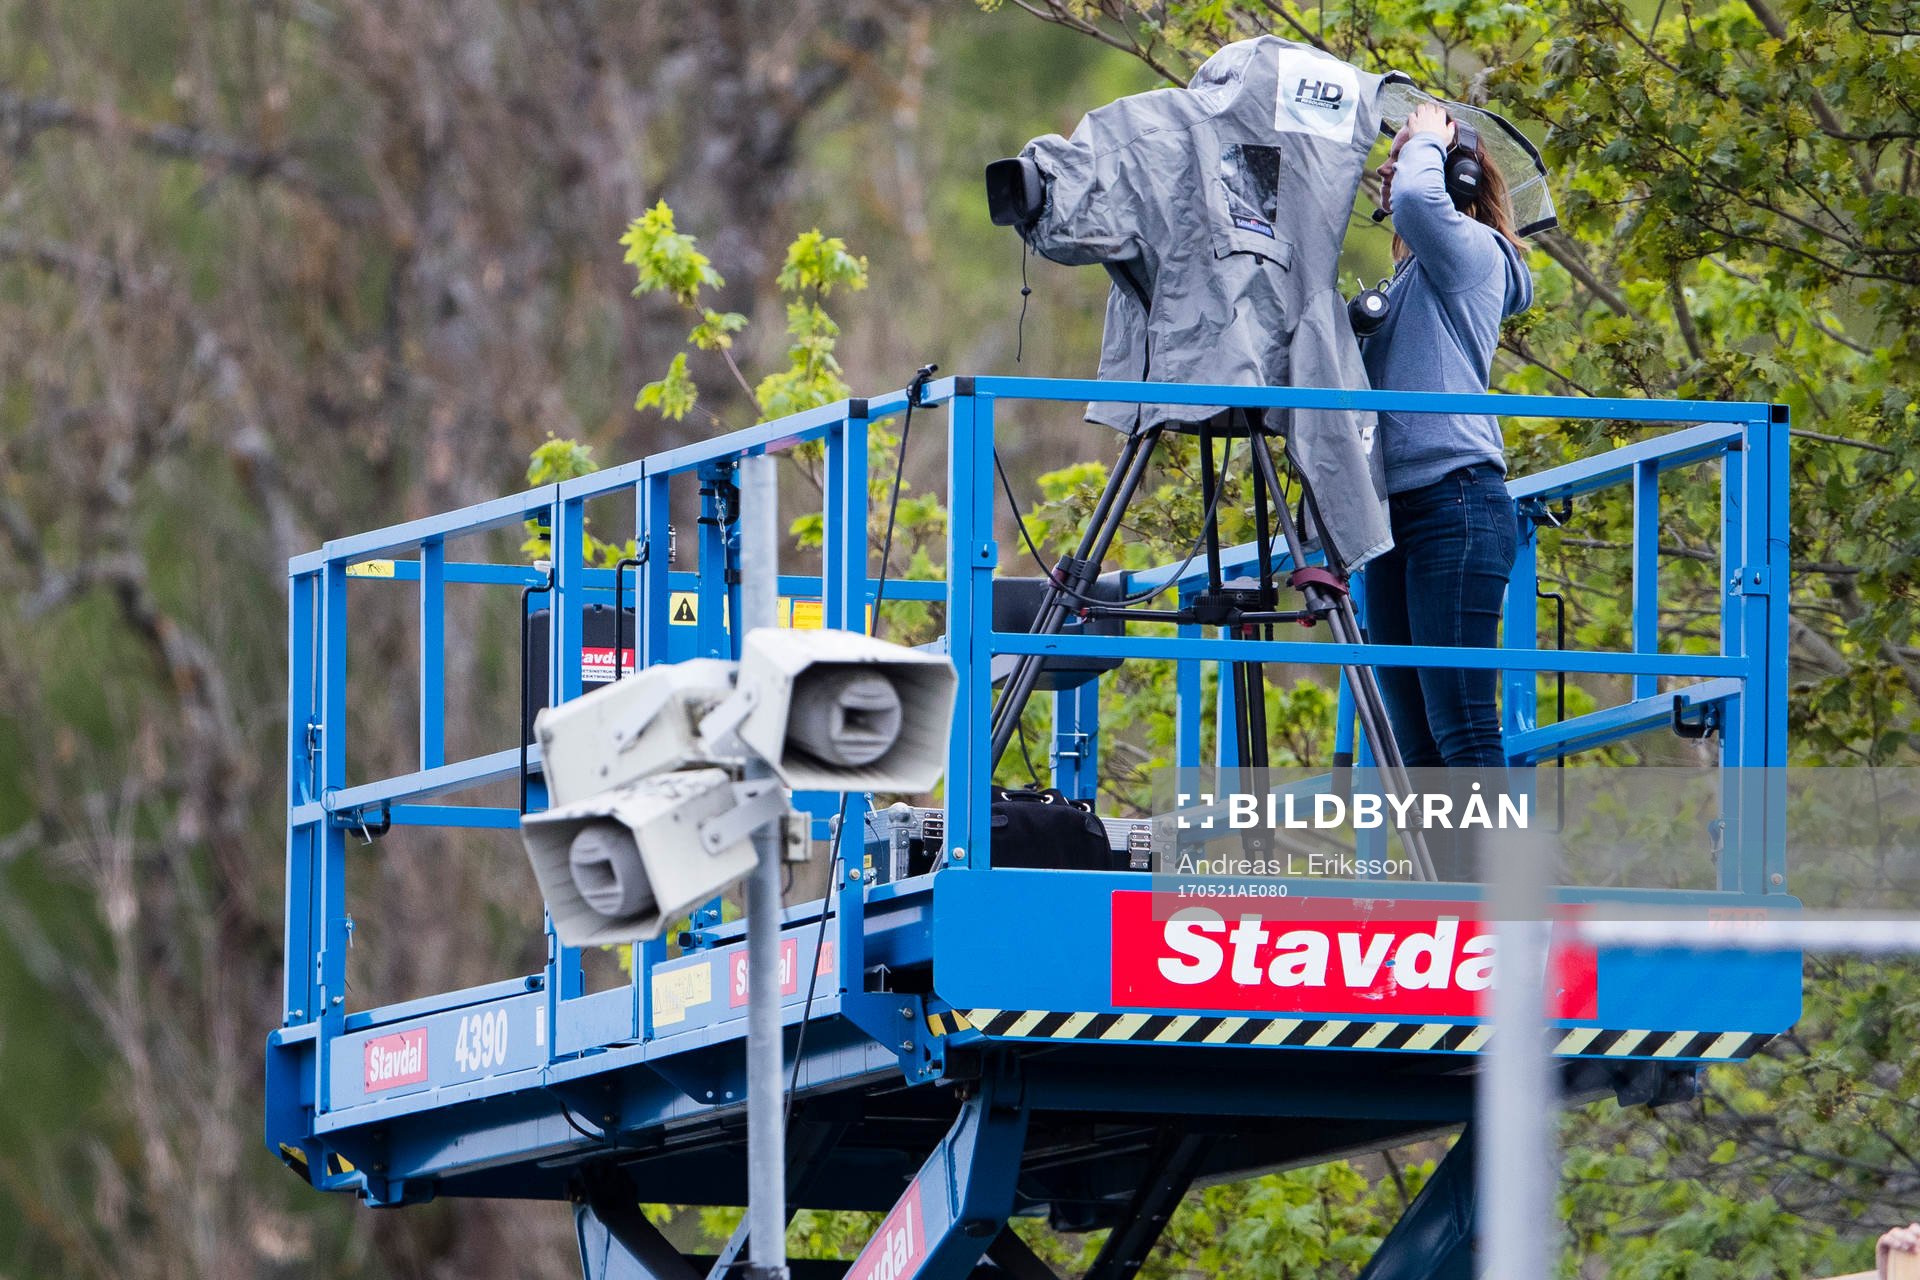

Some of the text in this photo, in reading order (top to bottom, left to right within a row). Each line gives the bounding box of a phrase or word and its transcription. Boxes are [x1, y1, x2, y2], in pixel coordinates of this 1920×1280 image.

[1296, 79, 1343, 102] HD
[1157, 906, 1554, 991] Stavda
[370, 1037, 422, 1082] Stavdal
[455, 1008, 508, 1073] 4390
